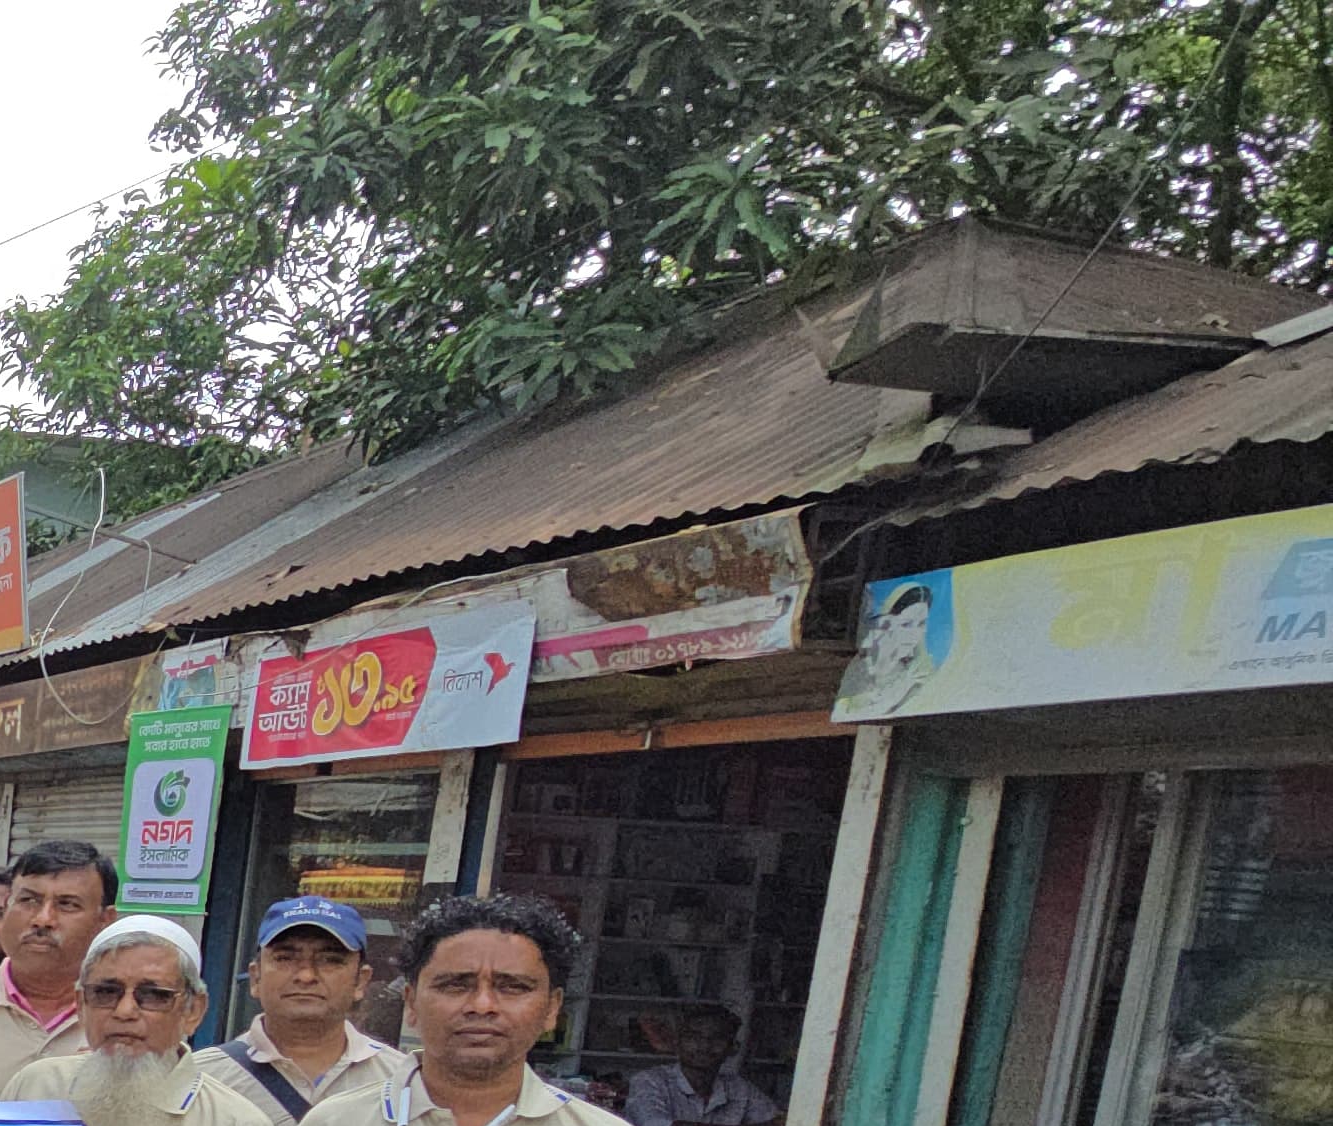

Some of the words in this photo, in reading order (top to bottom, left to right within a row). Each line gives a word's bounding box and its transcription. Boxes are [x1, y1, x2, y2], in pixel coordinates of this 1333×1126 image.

[270, 680, 311, 707] ক্যাশ
[443, 669, 483, 694] বিকাশ
[139, 720, 162, 737] কোটি
[164, 721, 198, 738] মানুষের
[258, 702, 309, 732] আউট
[141, 820, 193, 845] নগদ
[139, 846, 191, 863] ইসলামিক
